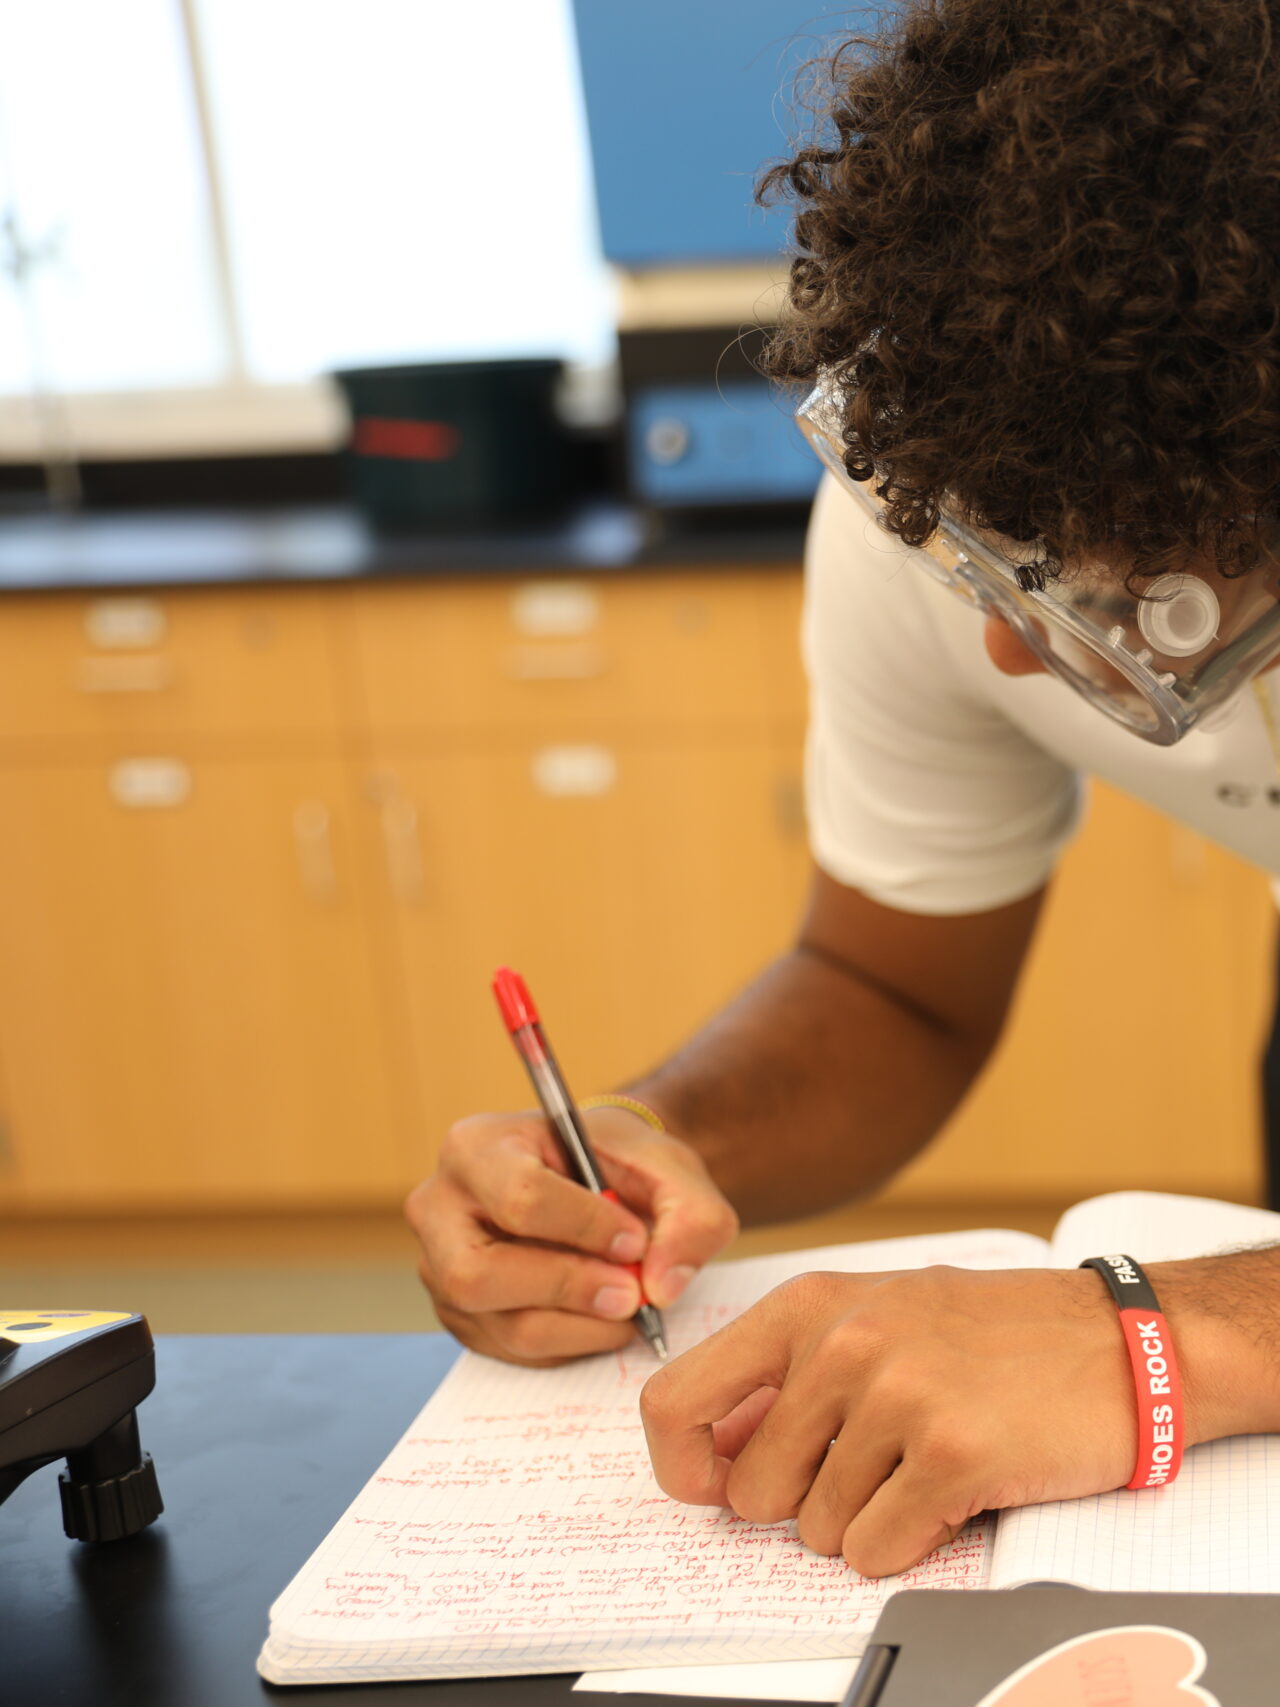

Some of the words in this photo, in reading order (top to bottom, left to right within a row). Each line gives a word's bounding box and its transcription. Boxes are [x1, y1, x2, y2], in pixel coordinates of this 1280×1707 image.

[1136, 1320, 1171, 1395] ROCK
[1145, 1404, 1175, 1486] SHOES
[783, 1553, 802, 1561] be
[579, 1566, 667, 1577] reduction
[403, 1582, 420, 1596] by
[645, 1584, 665, 1597] by
[684, 1596, 721, 1607] the
[742, 1595, 850, 1605] determine
